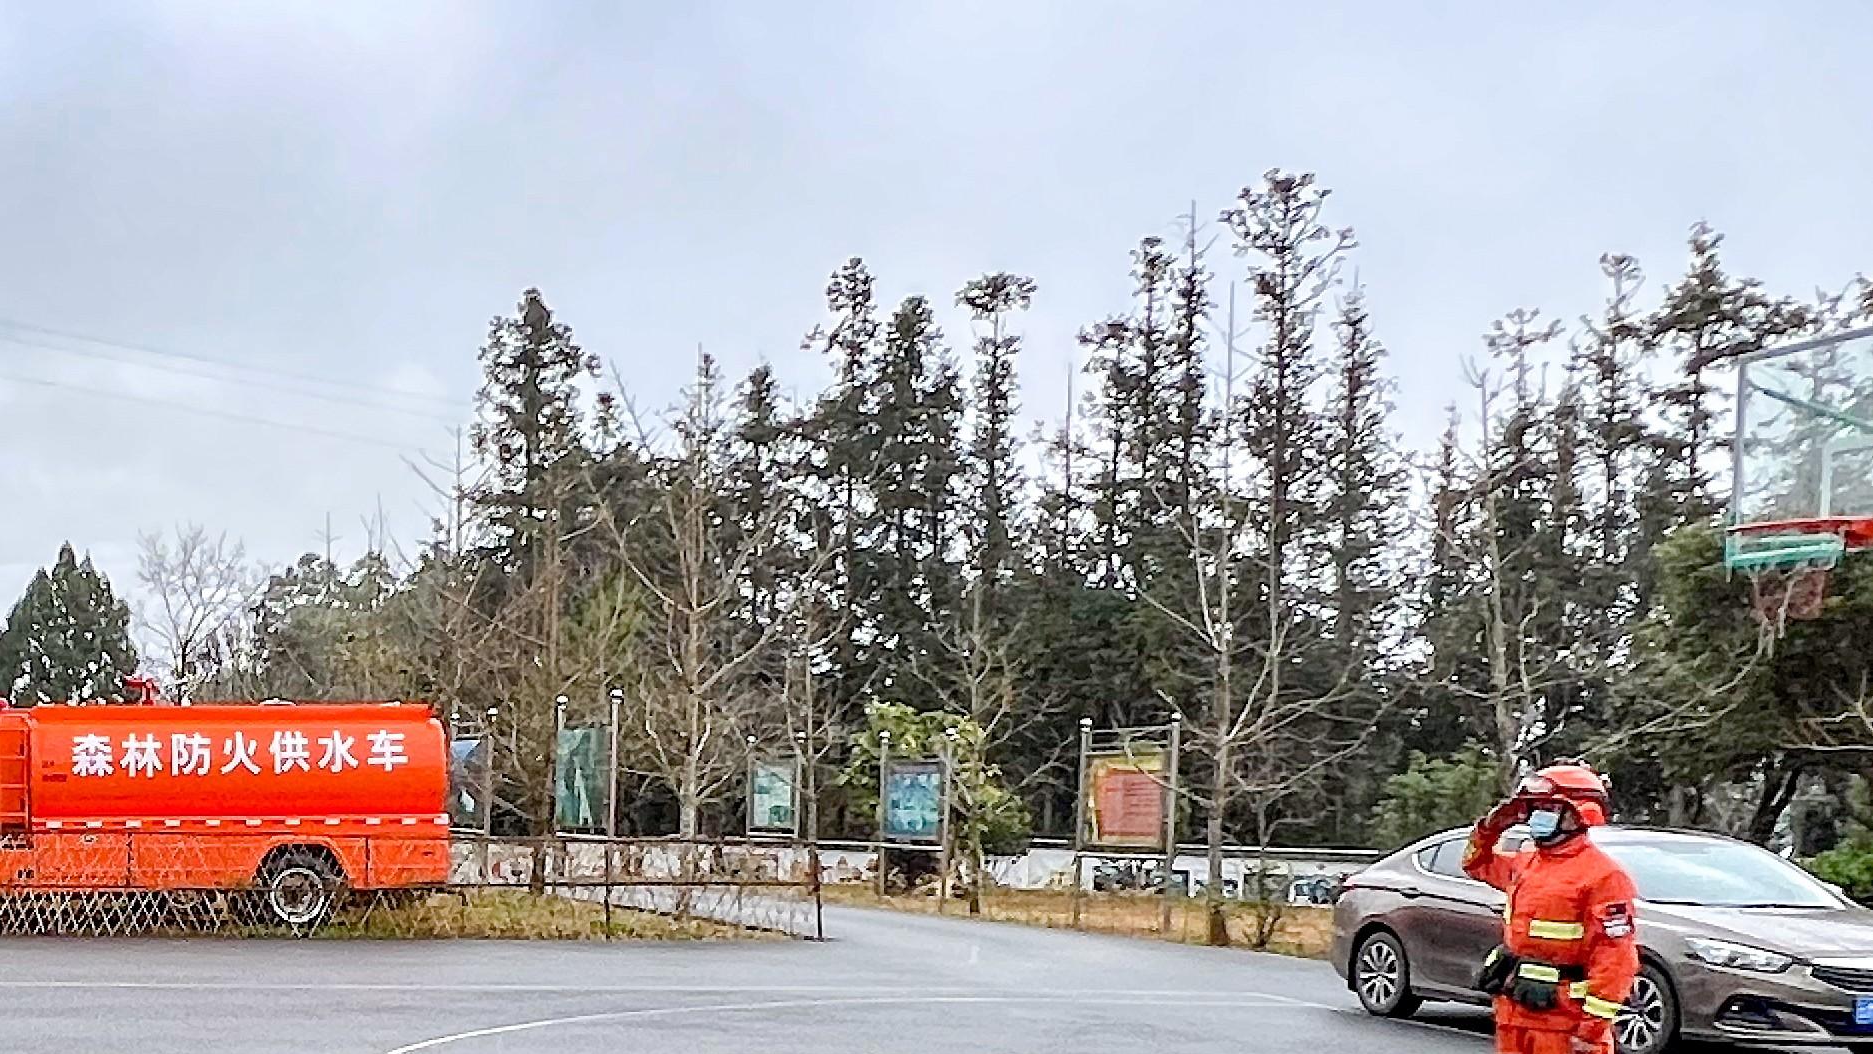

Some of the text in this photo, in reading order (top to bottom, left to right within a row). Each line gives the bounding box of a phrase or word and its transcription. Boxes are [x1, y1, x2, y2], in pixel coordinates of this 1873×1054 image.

[70, 729, 410, 778] 森林防火供水车
